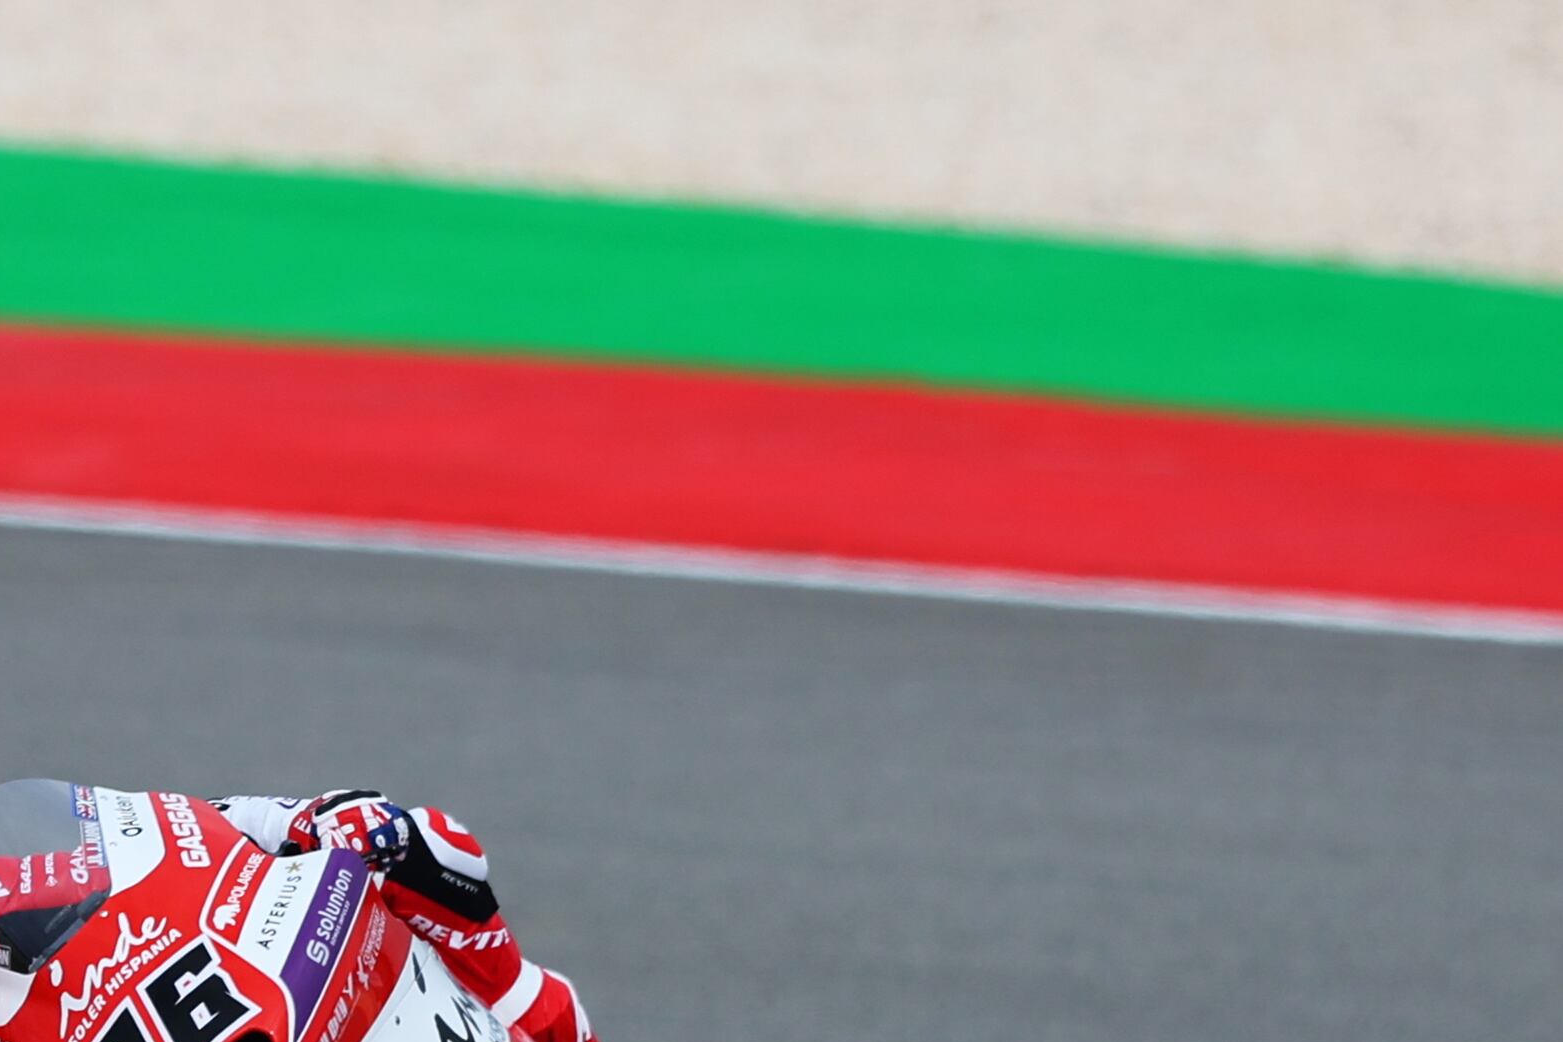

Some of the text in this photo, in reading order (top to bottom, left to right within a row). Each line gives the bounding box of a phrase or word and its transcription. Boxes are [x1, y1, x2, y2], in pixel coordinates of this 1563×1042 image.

[159, 792, 211, 868] GASGAS
[227, 852, 266, 904] POLARCUBE
[257, 875, 302, 951] ASTERIUS
[316, 868, 353, 941] solunion
[49, 912, 167, 1039] inde
[104, 928, 182, 996] HISPANIA
